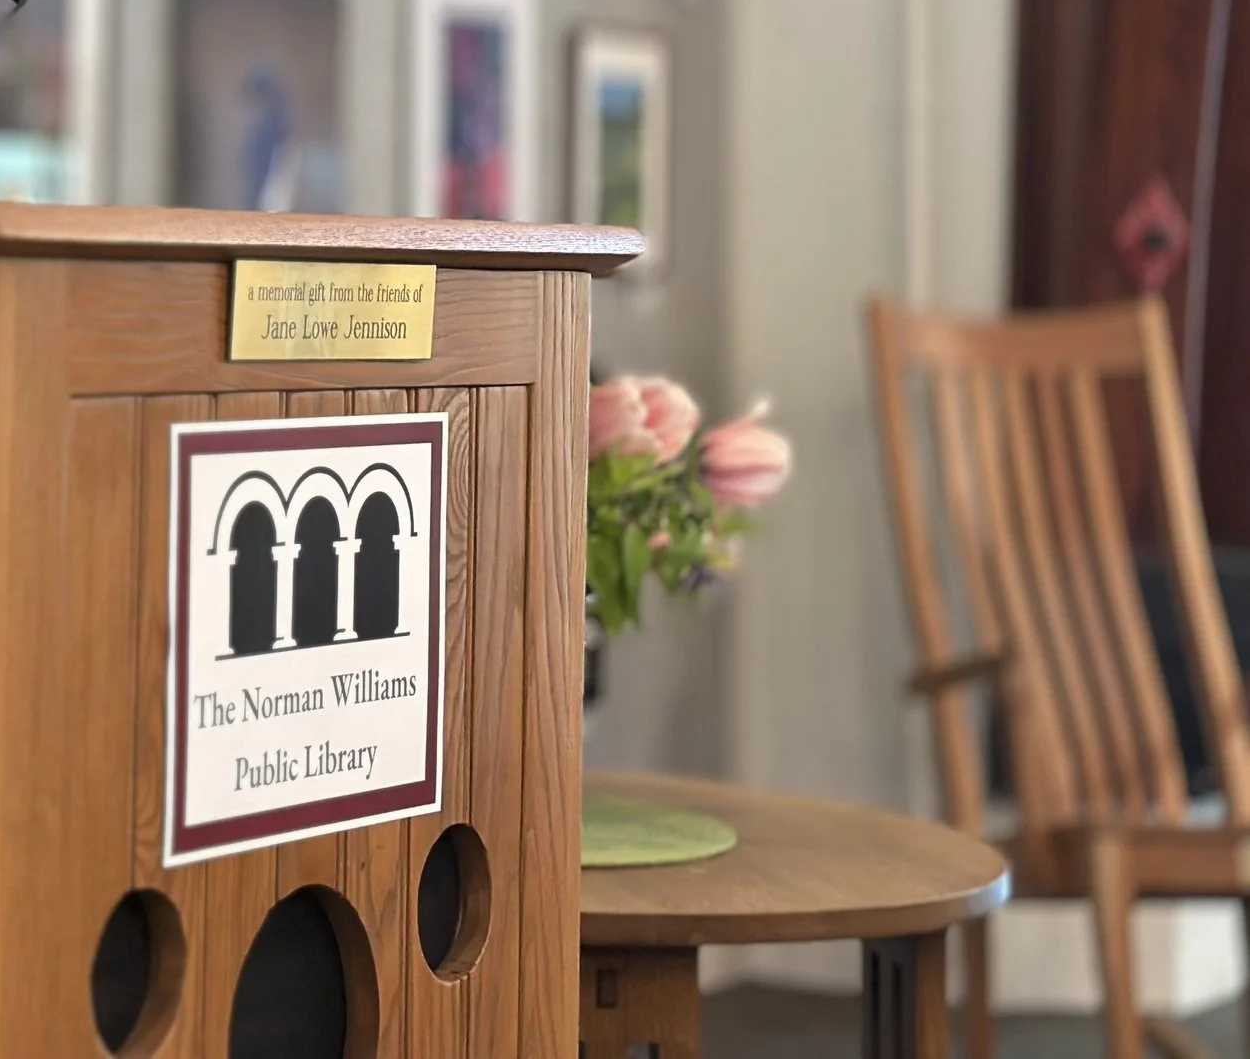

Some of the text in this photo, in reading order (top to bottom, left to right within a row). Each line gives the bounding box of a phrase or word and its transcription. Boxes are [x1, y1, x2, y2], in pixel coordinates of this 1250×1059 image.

[248, 281, 424, 306] a memorial gift from the friends of
[261, 314, 407, 340] Jane Lowe Jennison
[193, 668, 417, 729] The Norman Williams
[234, 740, 378, 791] Public Library
